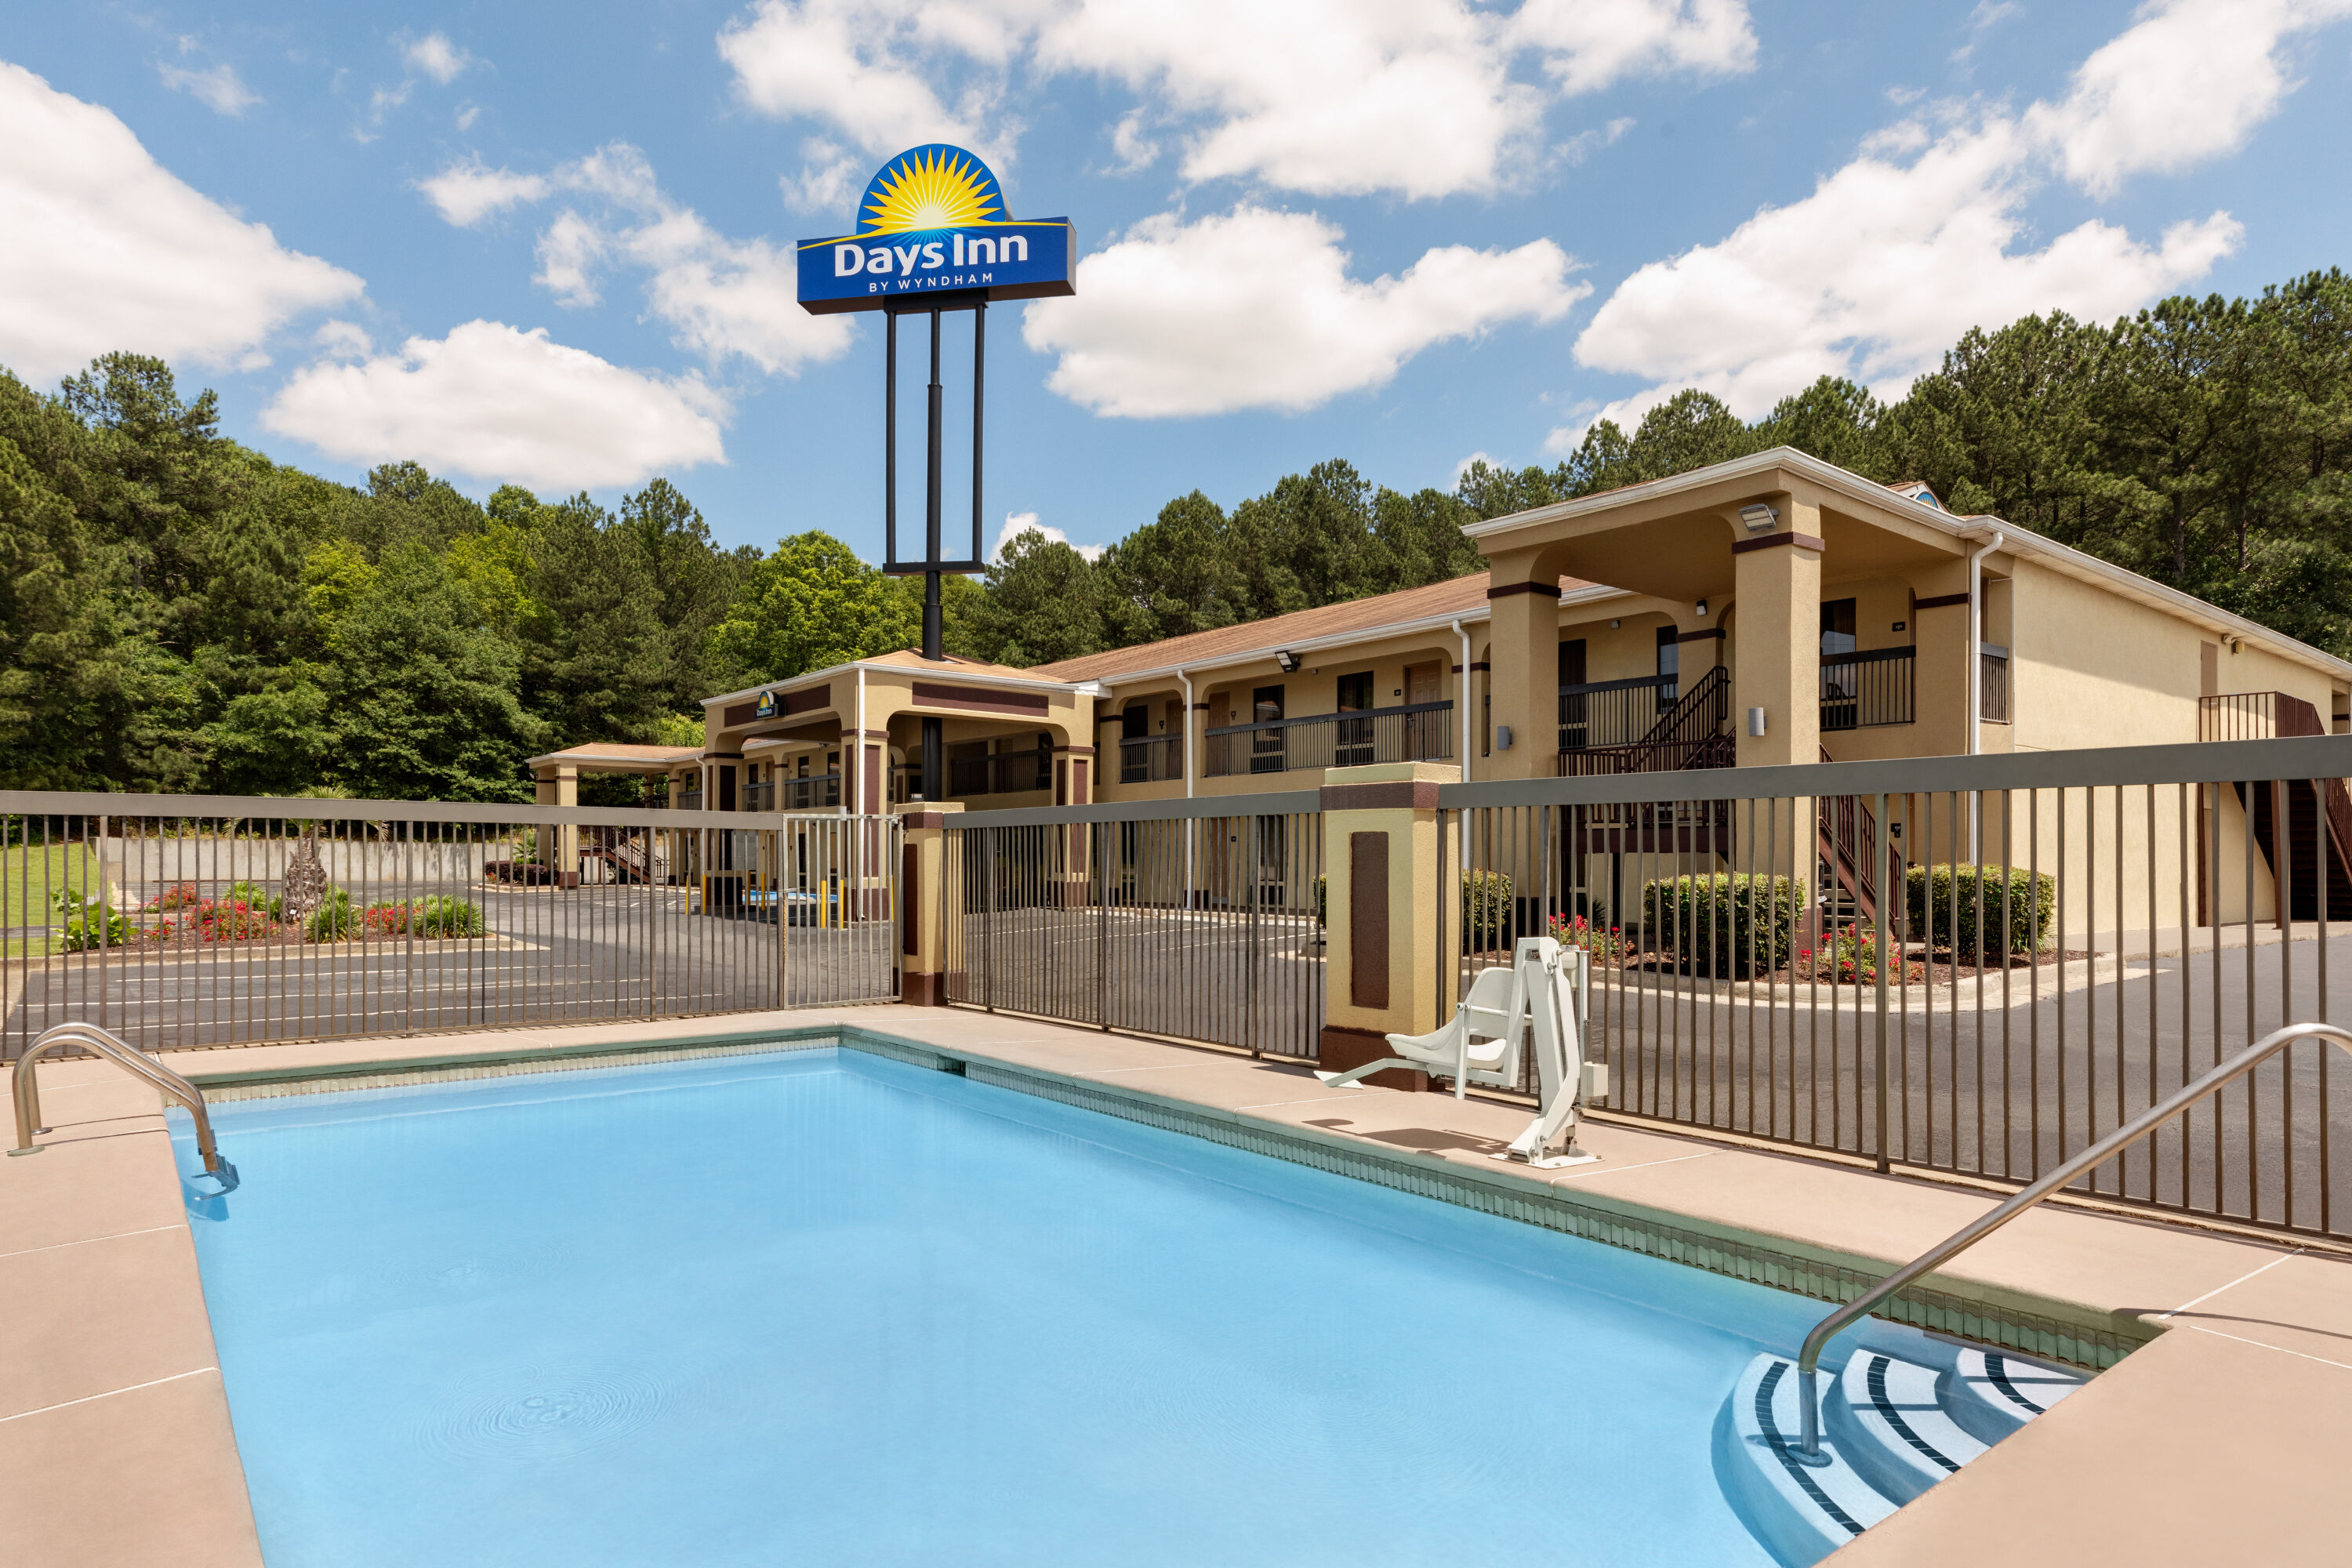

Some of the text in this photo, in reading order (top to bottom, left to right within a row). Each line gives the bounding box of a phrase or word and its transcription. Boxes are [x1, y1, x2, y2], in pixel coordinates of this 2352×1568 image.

[834, 234, 1028, 277] Days Inn
[869, 272, 993, 293] BY WYNDHAM
